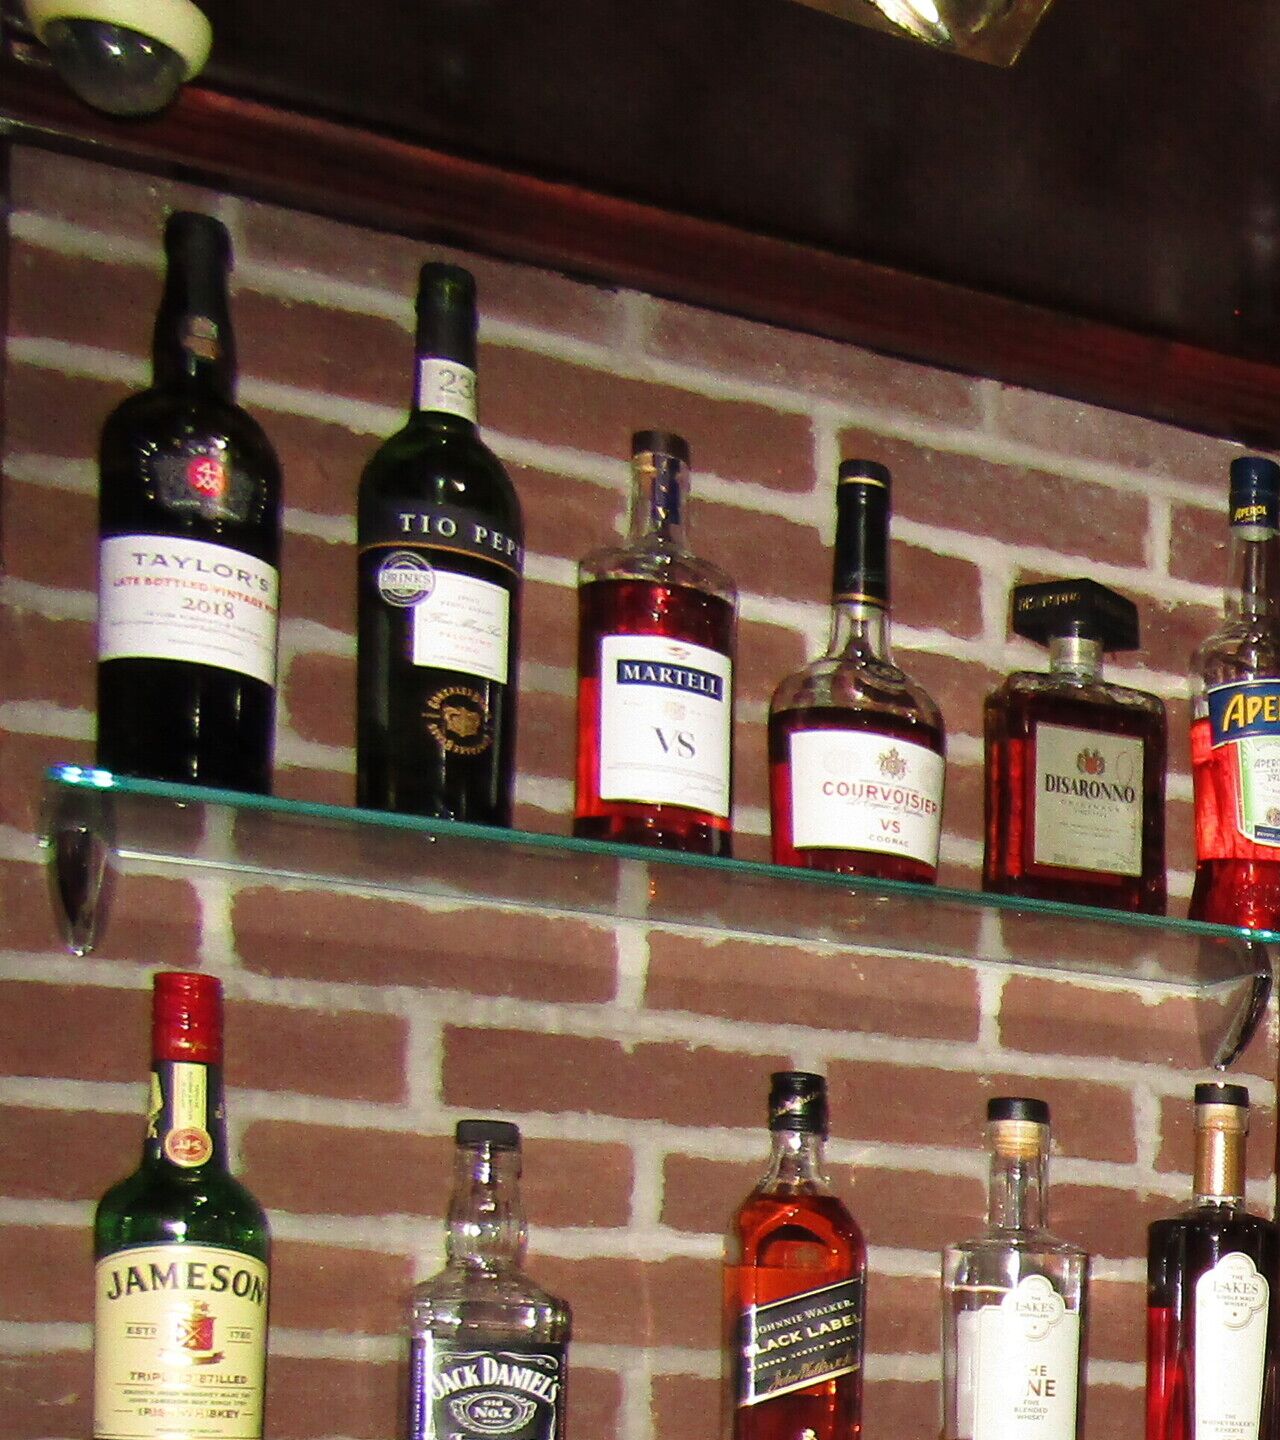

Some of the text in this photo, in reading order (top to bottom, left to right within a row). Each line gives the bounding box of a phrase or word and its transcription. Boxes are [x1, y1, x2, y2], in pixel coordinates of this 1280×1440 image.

[399, 513, 457, 537] TIO
[131, 551, 270, 593] TAYLOR'S
[381, 570, 432, 586] DRINKS
[143, 577, 209, 593] BOTTLED
[181, 597, 236, 621] 2018
[624, 664, 719, 695] MARTELL
[653, 726, 696, 760] VS
[822, 780, 939, 815] COURVOISIER
[1044, 772, 1136, 804] DISARONNO
[879, 818, 902, 834] VS
[868, 834, 909, 848] COGNAC
[106, 1262, 266, 1307] JAMESON
[1212, 1281, 1259, 1295] LAKES
[1015, 1302, 1055, 1313] LAKES
[756, 1313, 804, 1338] OHNNIE
[129, 1371, 248, 1385] TRIPL DSTILLED
[431, 1357, 561, 1404] JACK DANIEL'S
[473, 1406, 513, 1419] No.7
